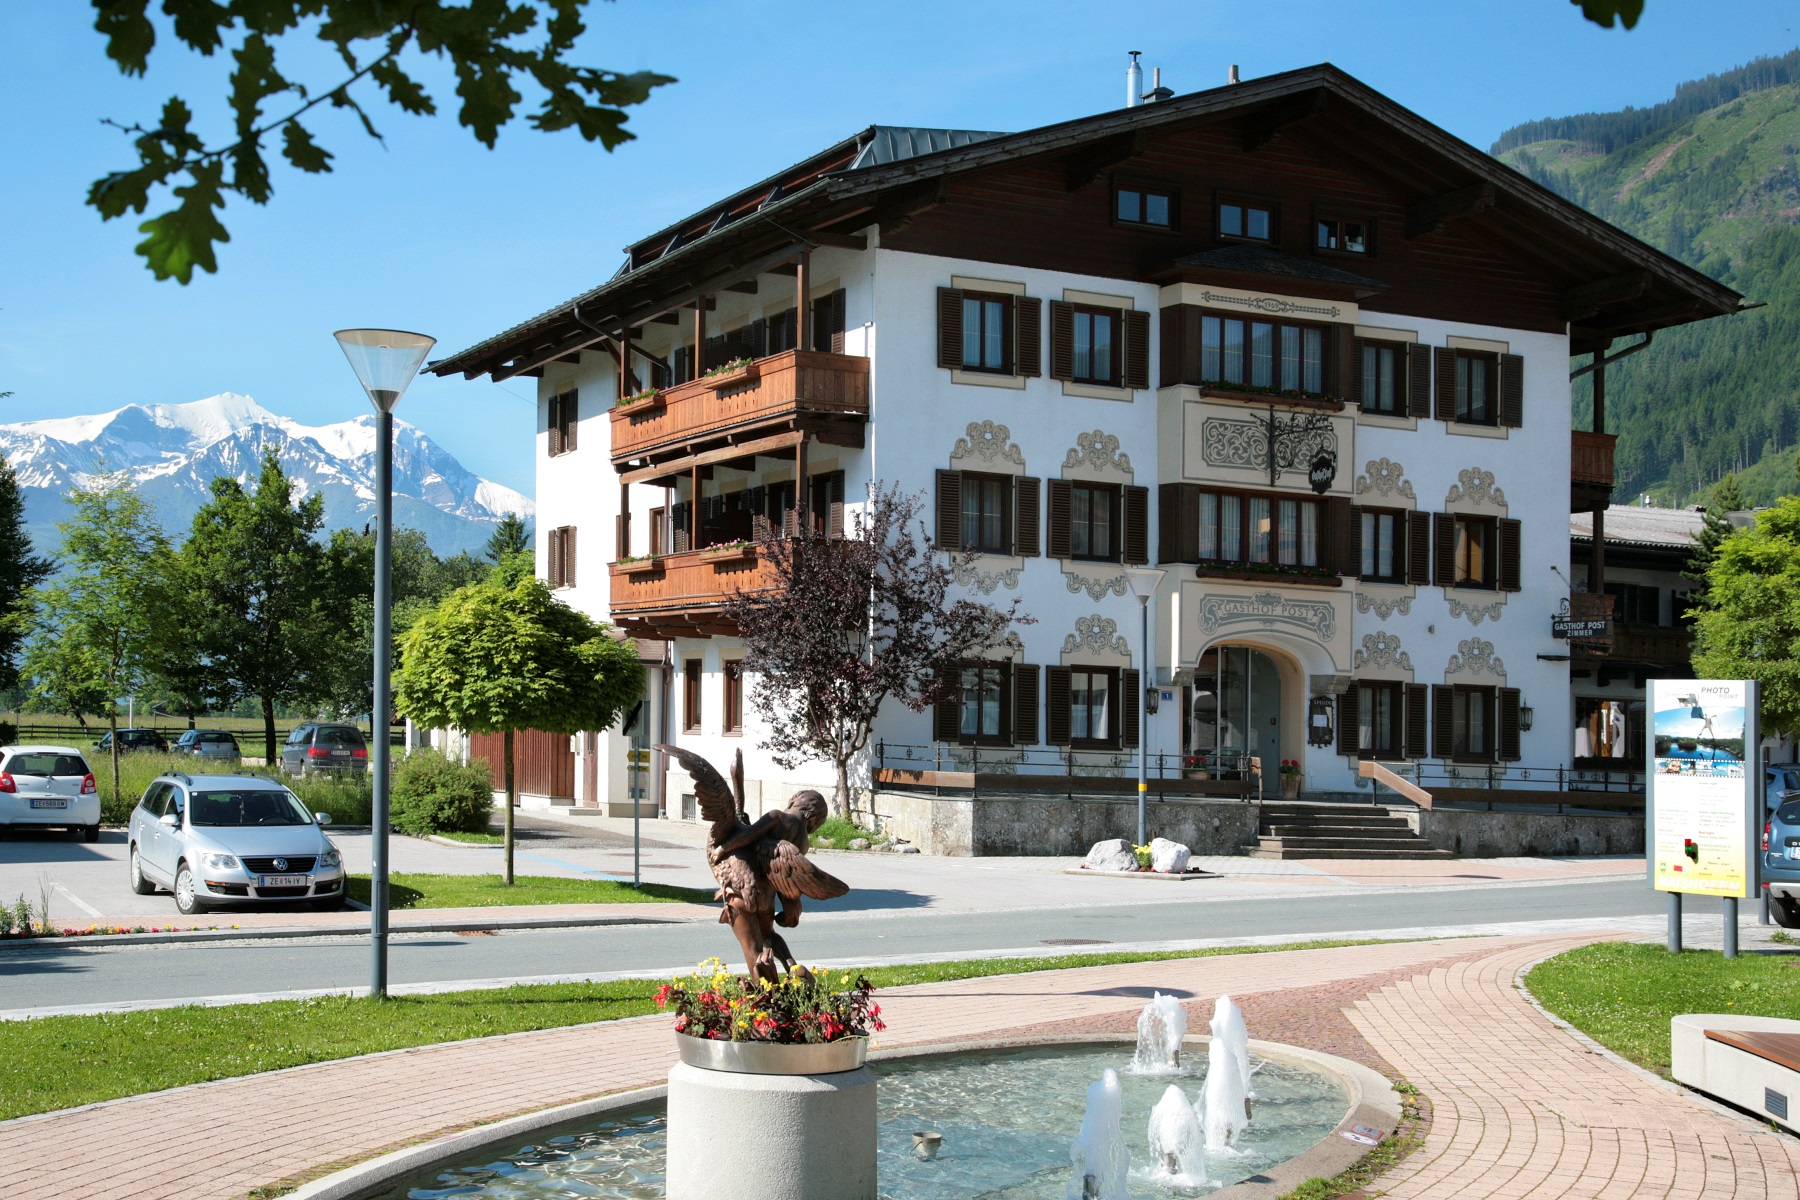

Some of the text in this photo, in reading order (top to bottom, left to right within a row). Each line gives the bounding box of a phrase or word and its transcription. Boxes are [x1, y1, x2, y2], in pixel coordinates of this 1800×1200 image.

[1224, 603, 1310, 617] GASTHOF POST
[1554, 621, 1606, 630] GASTHOF POST
[1701, 686, 1730, 694] PHOTO
[1658, 876, 1741, 892] MAISHOFEN
